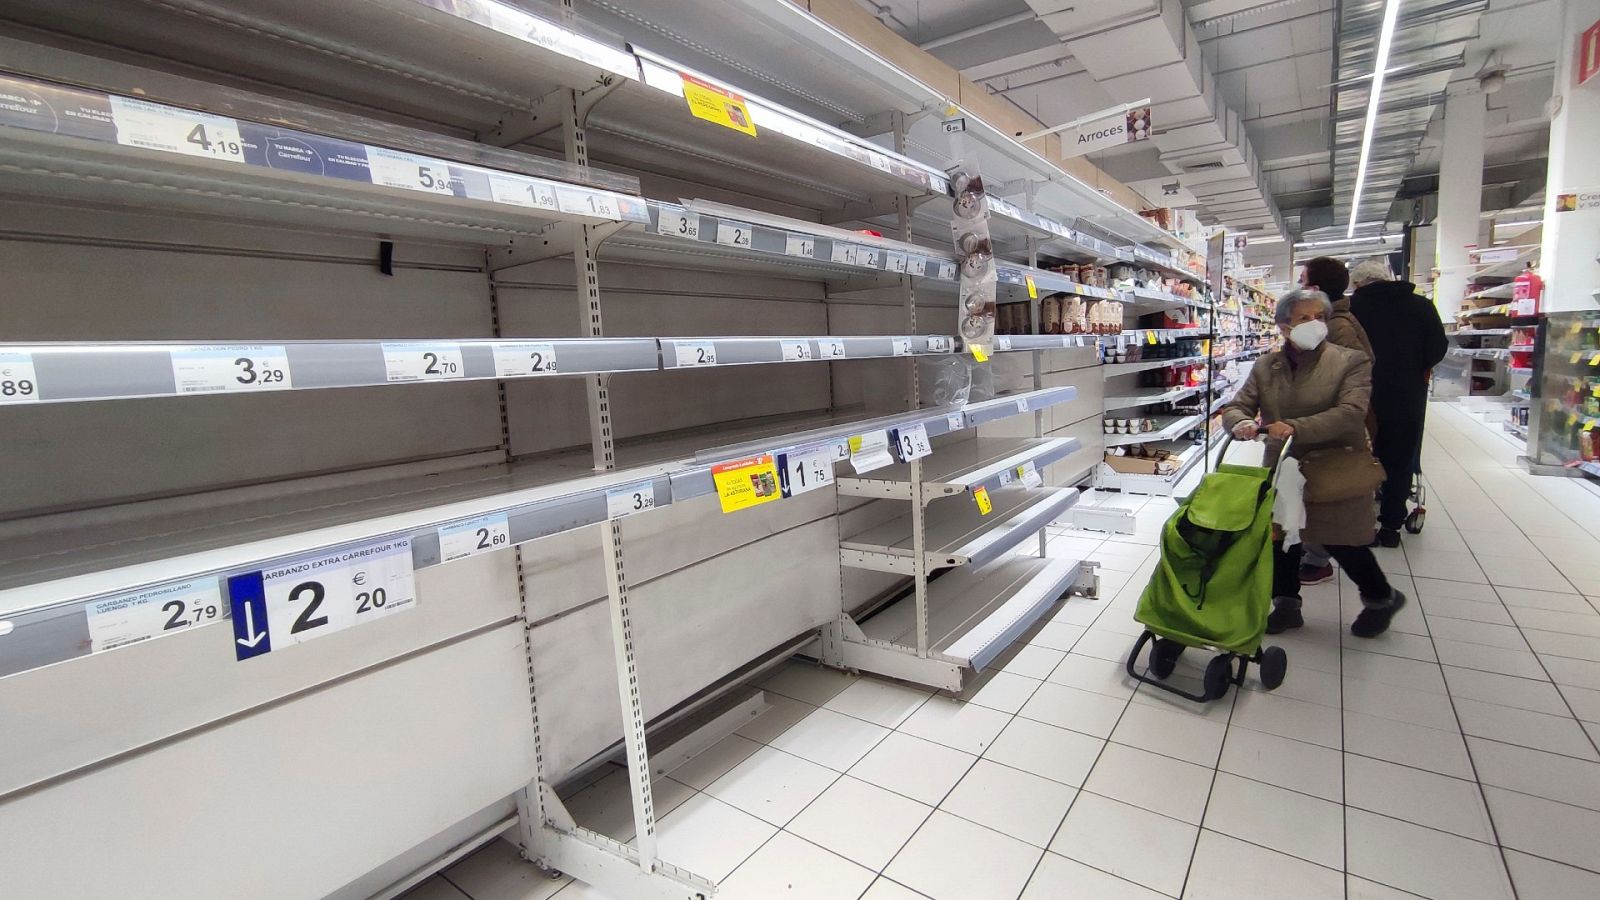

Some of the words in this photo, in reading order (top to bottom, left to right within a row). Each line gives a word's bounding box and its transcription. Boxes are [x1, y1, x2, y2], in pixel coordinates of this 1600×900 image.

[187, 123, 239, 155] 4,19
[1077, 124, 1123, 144] Arroces
[526, 184, 553, 206] 1,99
[586, 195, 611, 215] 1,83
[679, 217, 697, 236] 3,65
[423, 352, 457, 375] 2,70
[530, 352, 557, 372] 2,49
[696, 347, 715, 364] 2,95
[234, 357, 283, 385] 3,29
[903, 435, 913, 456] 3
[796, 461, 806, 487] 1
[814, 469, 825, 482] 75
[633, 493, 654, 510] 3,29
[476, 528, 506, 550] 2,60
[261, 563, 310, 581] ARBANZO
[312, 557, 341, 569] EXTRA
[342, 544, 392, 562] CARREFOUR
[393, 540, 409, 550] 1KG
[161, 600, 217, 631] 2,79
[288, 581, 329, 635] 2
[355, 587, 387, 614] 20
